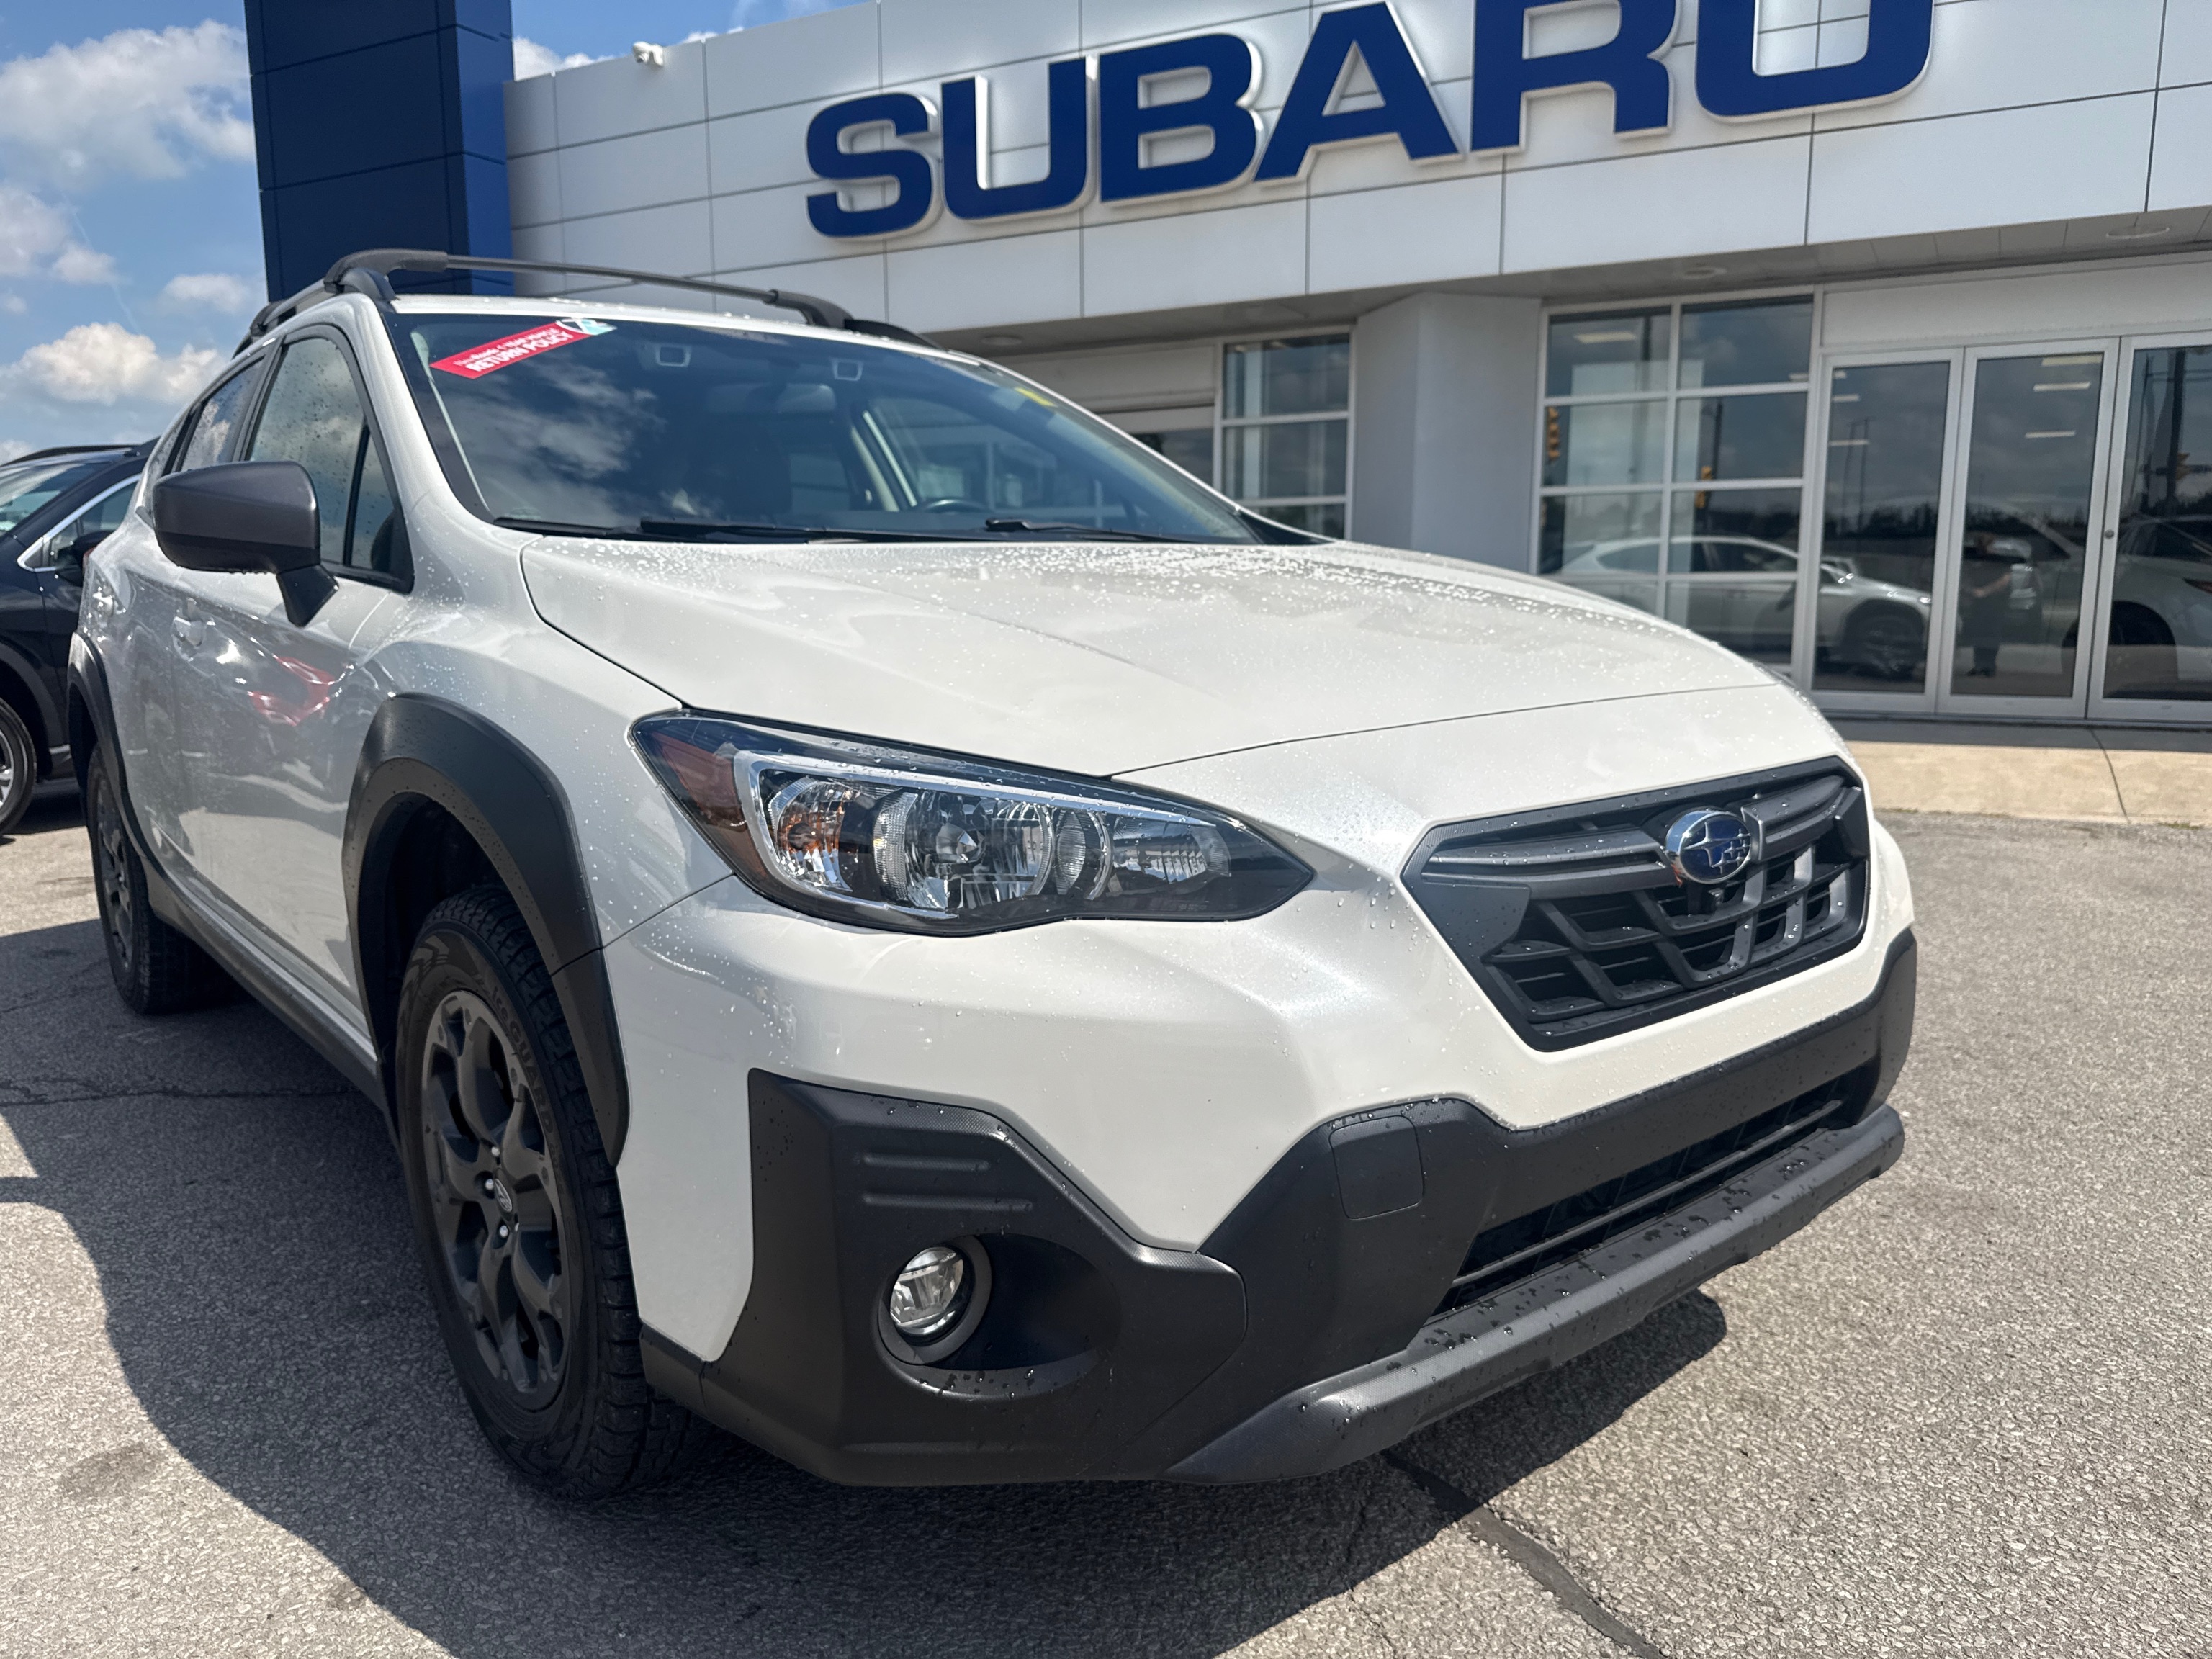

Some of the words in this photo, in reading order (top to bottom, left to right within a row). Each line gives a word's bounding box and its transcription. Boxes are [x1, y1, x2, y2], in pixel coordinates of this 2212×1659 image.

[806, 0, 1934, 238] SUBARU
[464, 347, 530, 372] RETURN
[522, 331, 574, 351] POLICY
